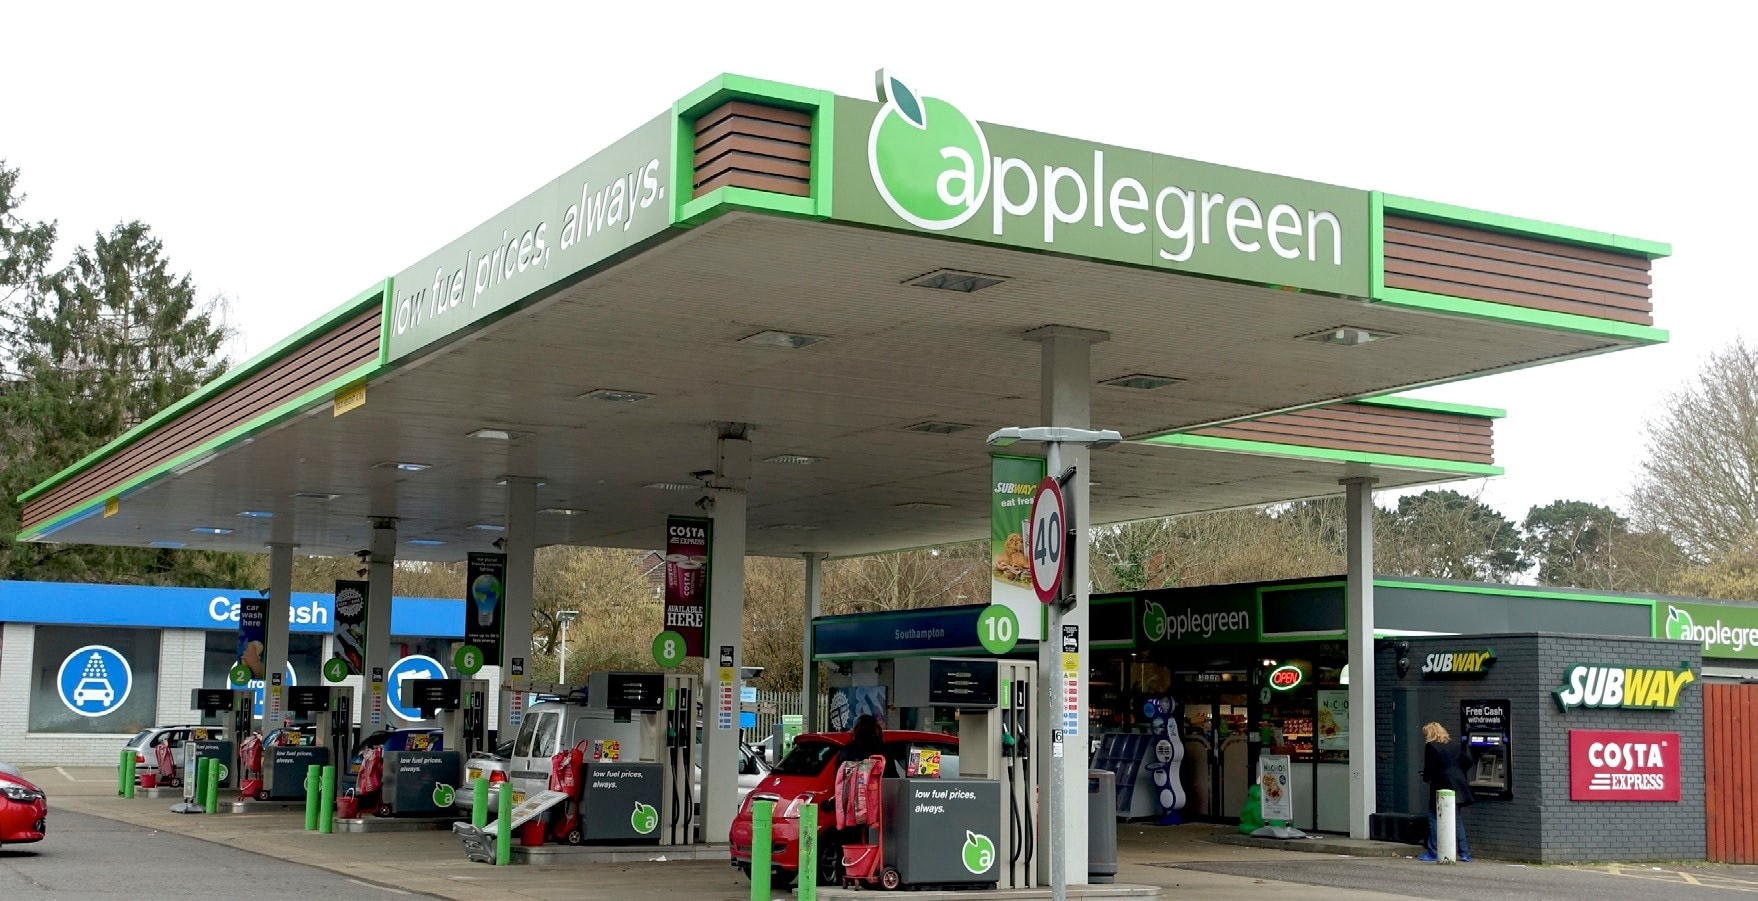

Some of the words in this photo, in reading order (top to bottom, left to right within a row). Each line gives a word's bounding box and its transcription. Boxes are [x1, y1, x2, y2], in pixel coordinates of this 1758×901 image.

[936, 146, 1342, 265] applegreen
[392, 290, 426, 338] low
[429, 249, 471, 319] fuel
[472, 220, 550, 308] prices,
[559, 158, 665, 251] always.
[994, 482, 1038, 495] SUBWAY
[1001, 498, 1016, 507] eat
[1017, 496, 1034, 506] fres
[669, 526, 705, 538] COSTA
[1034, 511, 1061, 566] 40
[679, 538, 706, 546] EXPRESS
[683, 572, 691, 596] COSTA
[209, 596, 241, 622] Ca
[241, 611, 263, 619] wash
[667, 605, 704, 614] AVAILABLE
[242, 618, 261, 627] here
[666, 613, 704, 628] HERE
[1155, 607, 1250, 641] applegreen
[895, 627, 945, 641] Southampton
[984, 616, 1012, 642] 10
[1680, 619, 1758, 652] applegre
[663, 639, 676, 660] 8
[463, 652, 475, 668] 6
[1421, 651, 1491, 673] SUBWAY
[236, 670, 245, 682] 2
[331, 663, 342, 677] 4
[247, 679, 265, 689] fro
[1273, 672, 1299, 685] OPEN
[1560, 665, 1695, 708] SUBWAY
[1465, 706, 1482, 716] Free
[1483, 706, 1503, 716] Cash
[1468, 716, 1501, 724] withdrawals
[1055, 731, 1062, 742] 6
[1588, 742, 1664, 771] COSTA
[606, 770, 620, 778] fuel
[620, 770, 643, 779] prices,
[1611, 773, 1664, 790] EXPRESS
[592, 781, 618, 789] always.
[914, 789, 931, 799] low
[931, 789, 948, 799] fuel
[948, 789, 977, 800] prices,
[914, 803, 945, 814] always.
[644, 815, 655, 829] a
[979, 849, 991, 867] a
